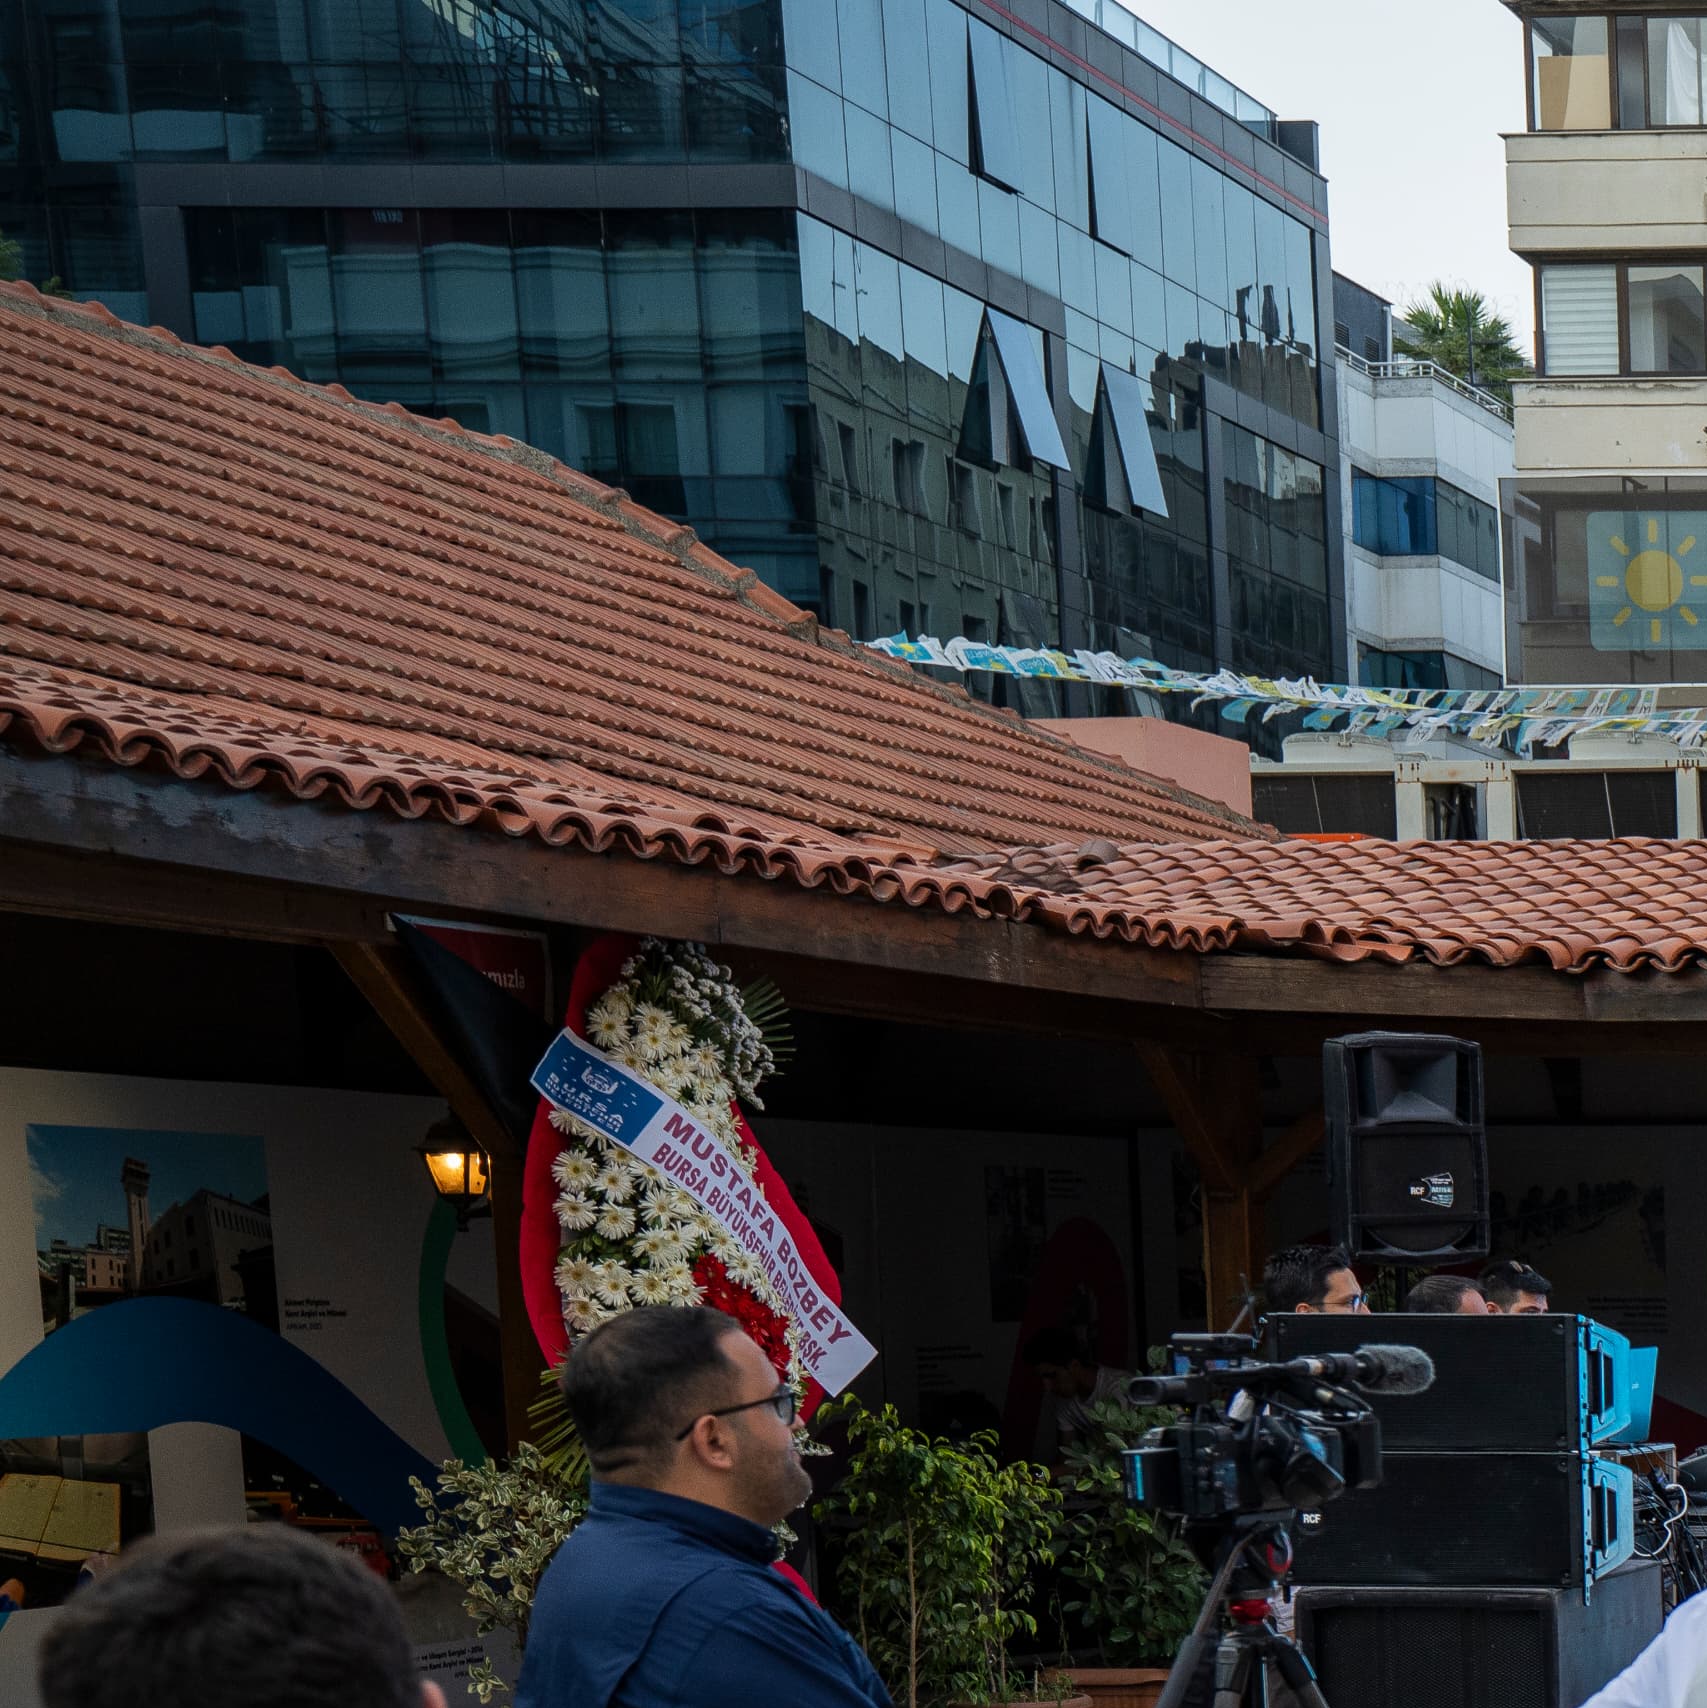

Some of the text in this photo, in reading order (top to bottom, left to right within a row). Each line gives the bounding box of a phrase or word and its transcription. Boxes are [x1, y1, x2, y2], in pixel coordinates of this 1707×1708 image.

[651, 1142, 710, 1197] BURSA
[706, 1185, 777, 1280] BÜYÜKŞEHİR
[663, 1112, 853, 1345] MUSTAFA BOZBEY
[1302, 1513, 1322, 1525] RCF
